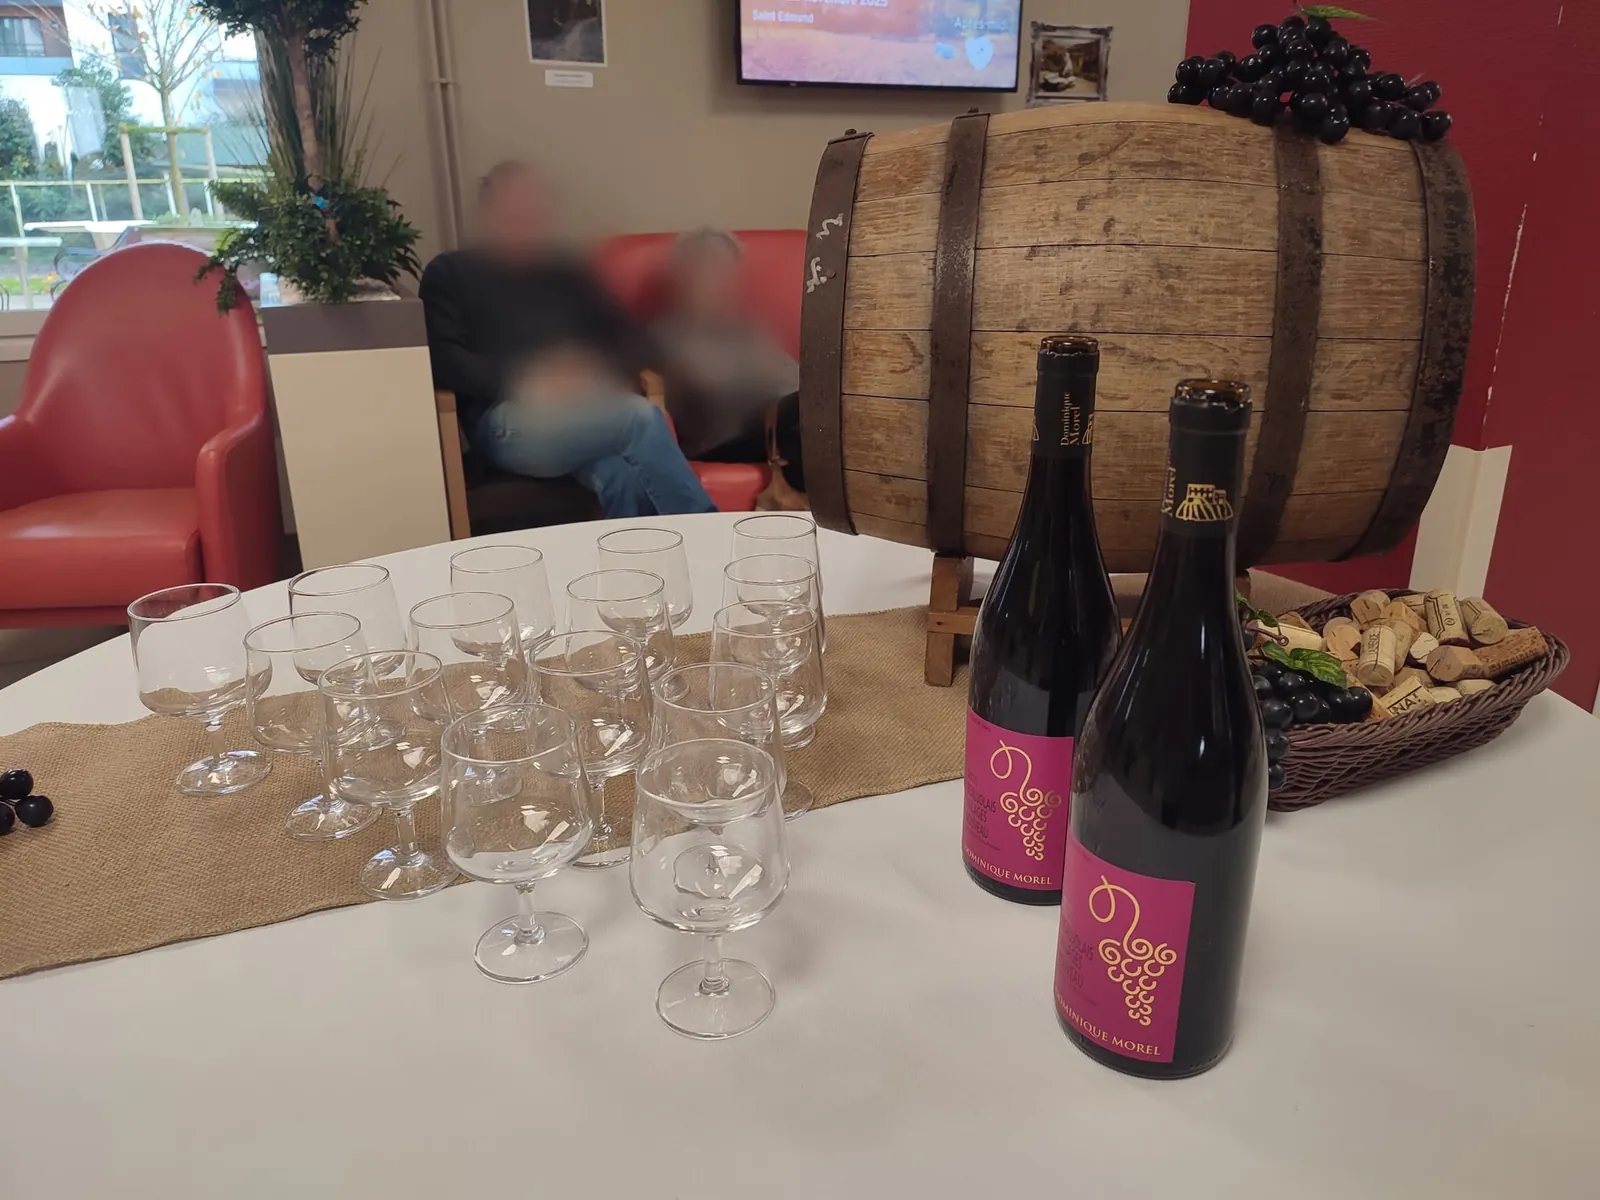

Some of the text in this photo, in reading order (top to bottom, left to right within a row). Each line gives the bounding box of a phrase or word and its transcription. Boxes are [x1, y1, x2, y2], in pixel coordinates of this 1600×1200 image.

[752, 9, 814, 24] Saint Edmond
[1060, 391, 1073, 446] Dominique
[1069, 406, 1080, 446] Morel
[1013, 872, 1053, 885] MOREL
[1111, 1036, 1161, 1056] MOREL
